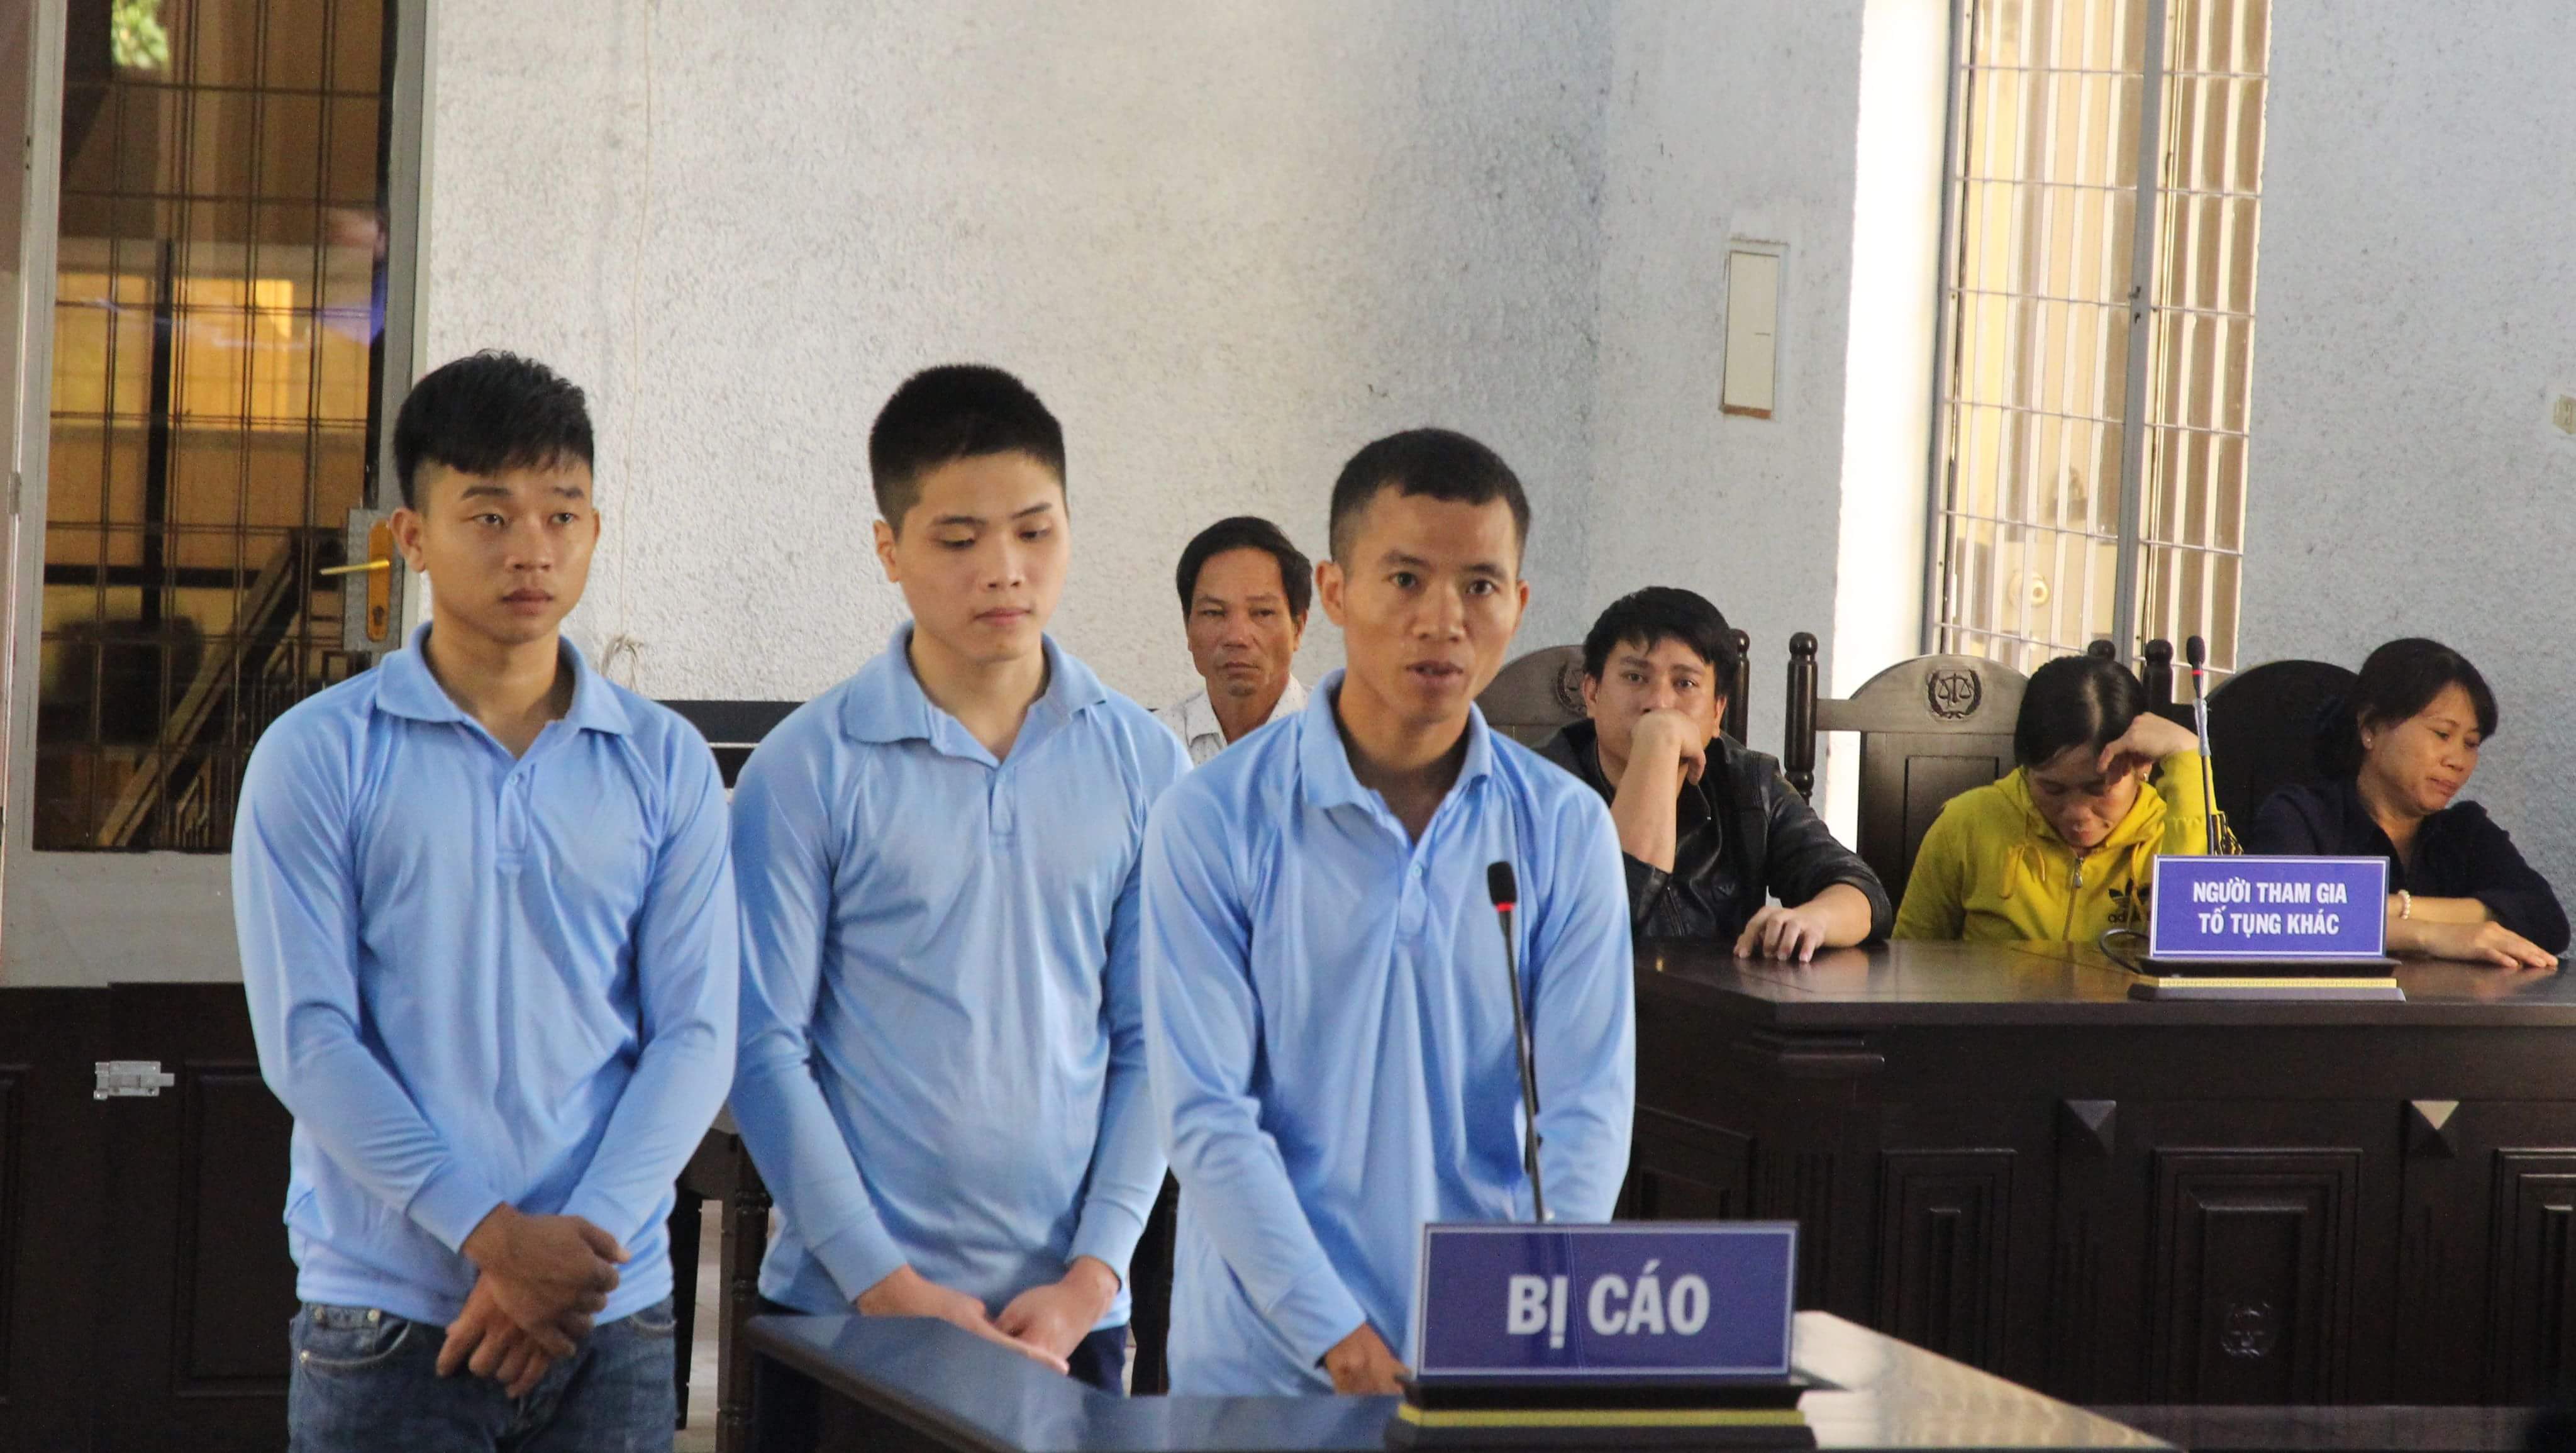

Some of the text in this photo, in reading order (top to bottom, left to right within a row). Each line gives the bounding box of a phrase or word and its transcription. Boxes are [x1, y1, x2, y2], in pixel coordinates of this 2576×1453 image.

[2193, 876, 2347, 904] NGƯỜI THAM GIA
[2198, 906, 2340, 938] TỐ TỤNG KHÁC
[1507, 1259, 1710, 1349] BỊ CÁO
